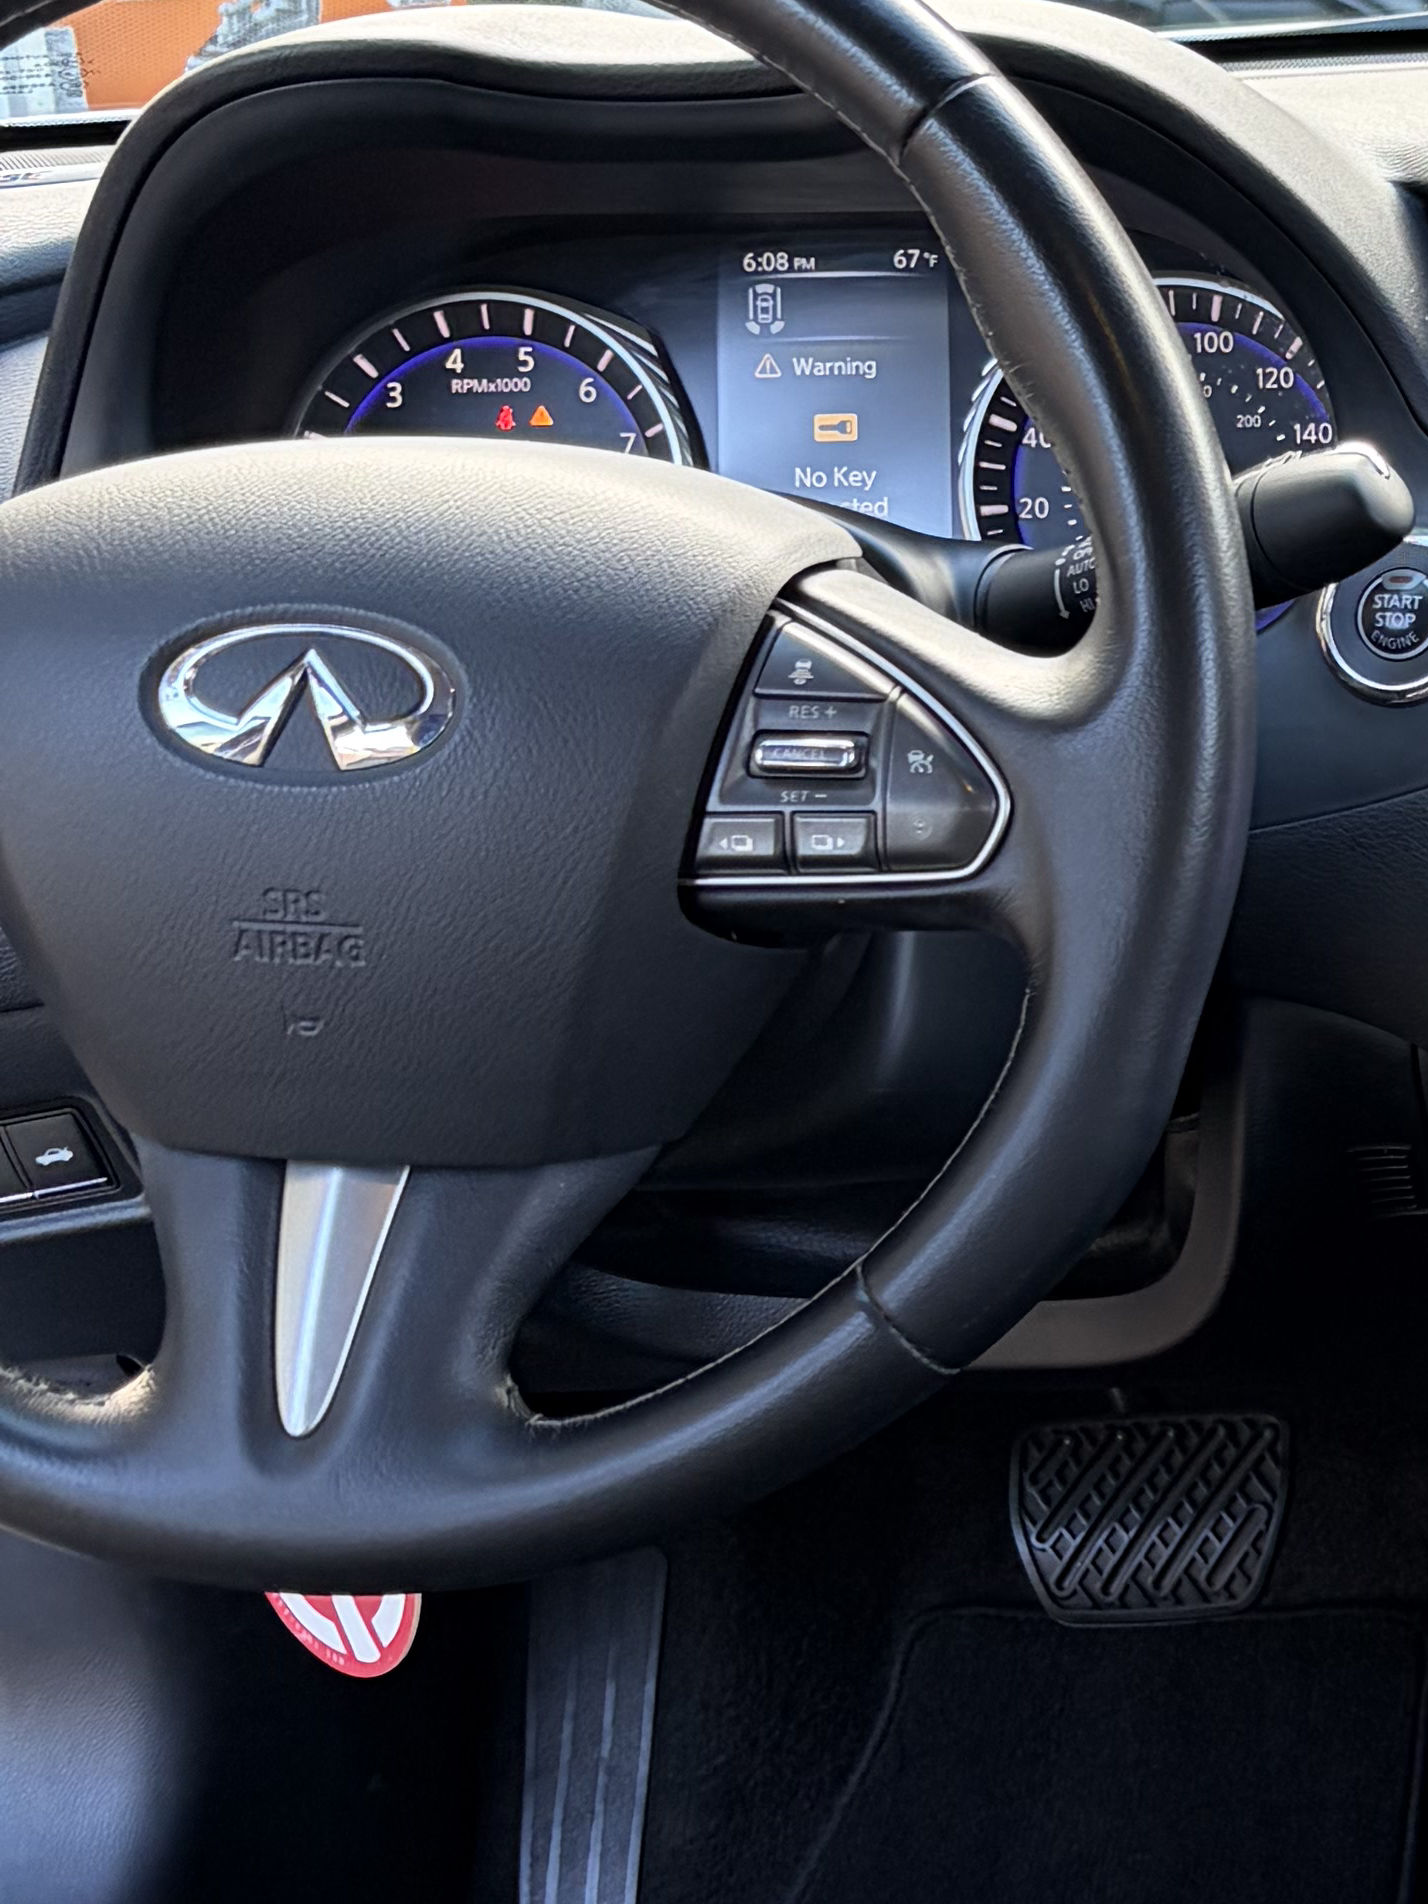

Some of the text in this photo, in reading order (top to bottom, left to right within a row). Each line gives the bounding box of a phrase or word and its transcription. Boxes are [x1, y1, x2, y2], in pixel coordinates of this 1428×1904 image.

[743, 252, 815, 272] 6:08 PM
[893, 250, 920, 269] 67
[1193, 331, 1234, 353] 100
[445, 348, 464, 373] 4
[517, 347, 535, 372] 5
[792, 357, 877, 379] Warning
[451, 378, 531, 394] RPMx1000
[1256, 367, 1294, 389] 120
[385, 382, 403, 408] 3
[579, 378, 597, 403] 6
[1236, 415, 1261, 428] 200
[620, 433, 637, 454] 7
[1293, 422, 1333, 445] 140
[794, 466, 877, 491] No Key
[1019, 497, 1049, 519] 20
[1073, 578, 1089, 594] LO
[1372, 594, 1423, 610] START
[1374, 611, 1416, 628] STOP
[1370, 629, 1420, 649] ENGINE
[789, 705, 819, 719] RES
[773, 747, 826, 760] CANCEL
[780, 790, 810, 803] SET
[262, 887, 325, 921] SRS
[233, 929, 366, 967] AIRBAG
